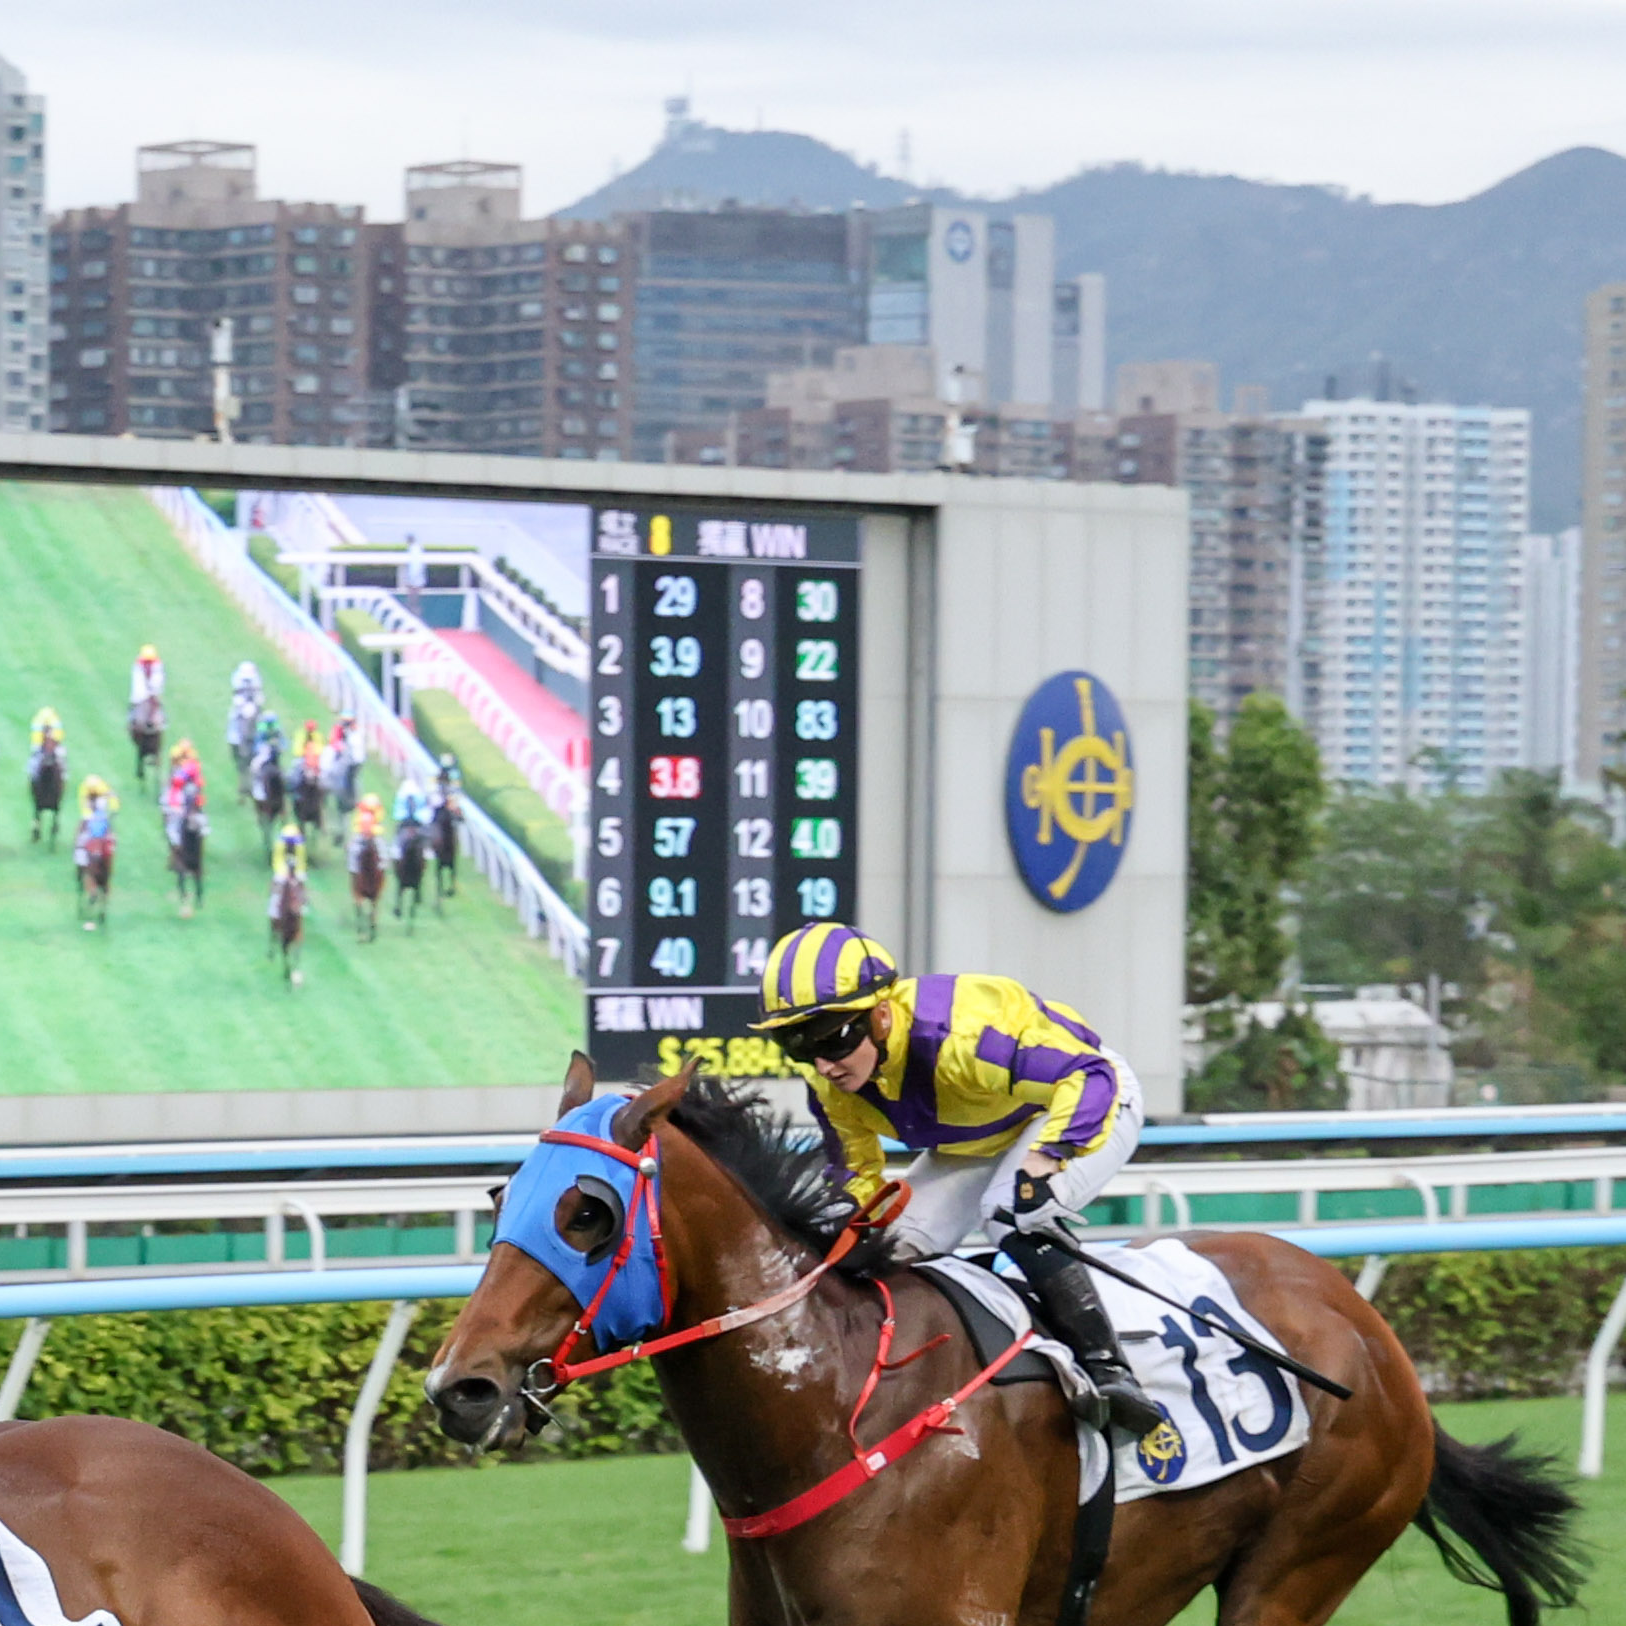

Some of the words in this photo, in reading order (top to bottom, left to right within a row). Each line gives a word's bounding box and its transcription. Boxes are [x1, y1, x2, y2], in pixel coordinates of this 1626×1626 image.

[750, 523, 807, 558] WIN
[600, 573, 620, 614] 1
[654, 575, 697, 617] 29
[740, 578, 765, 619] 8
[797, 580, 839, 622] 30
[597, 634, 623, 675] 2
[650, 636, 701, 677] 3.9
[740, 638, 765, 679] 9
[796, 640, 838, 681] 22
[598, 695, 623, 736] 3
[656, 697, 697, 738] 13
[734, 699, 774, 739] 10
[796, 700, 838, 740] 83
[597, 757, 622, 796] 4
[650, 757, 701, 798] 3.8
[734, 759, 769, 798] 11
[796, 759, 837, 799] 39
[598, 817, 623, 857] 5
[654, 817, 697, 857] 57
[733, 818, 773, 857] 12
[597, 877, 622, 917] 6
[649, 877, 697, 917] 9.1
[733, 878, 772, 917] 13
[797, 878, 837, 917] 19
[597, 938, 621, 977] 7
[650, 937, 695, 977] 40
[732, 938, 769, 976] 14
[648, 997, 704, 1030] WIN
[1159, 1294, 1294, 1466] 13
